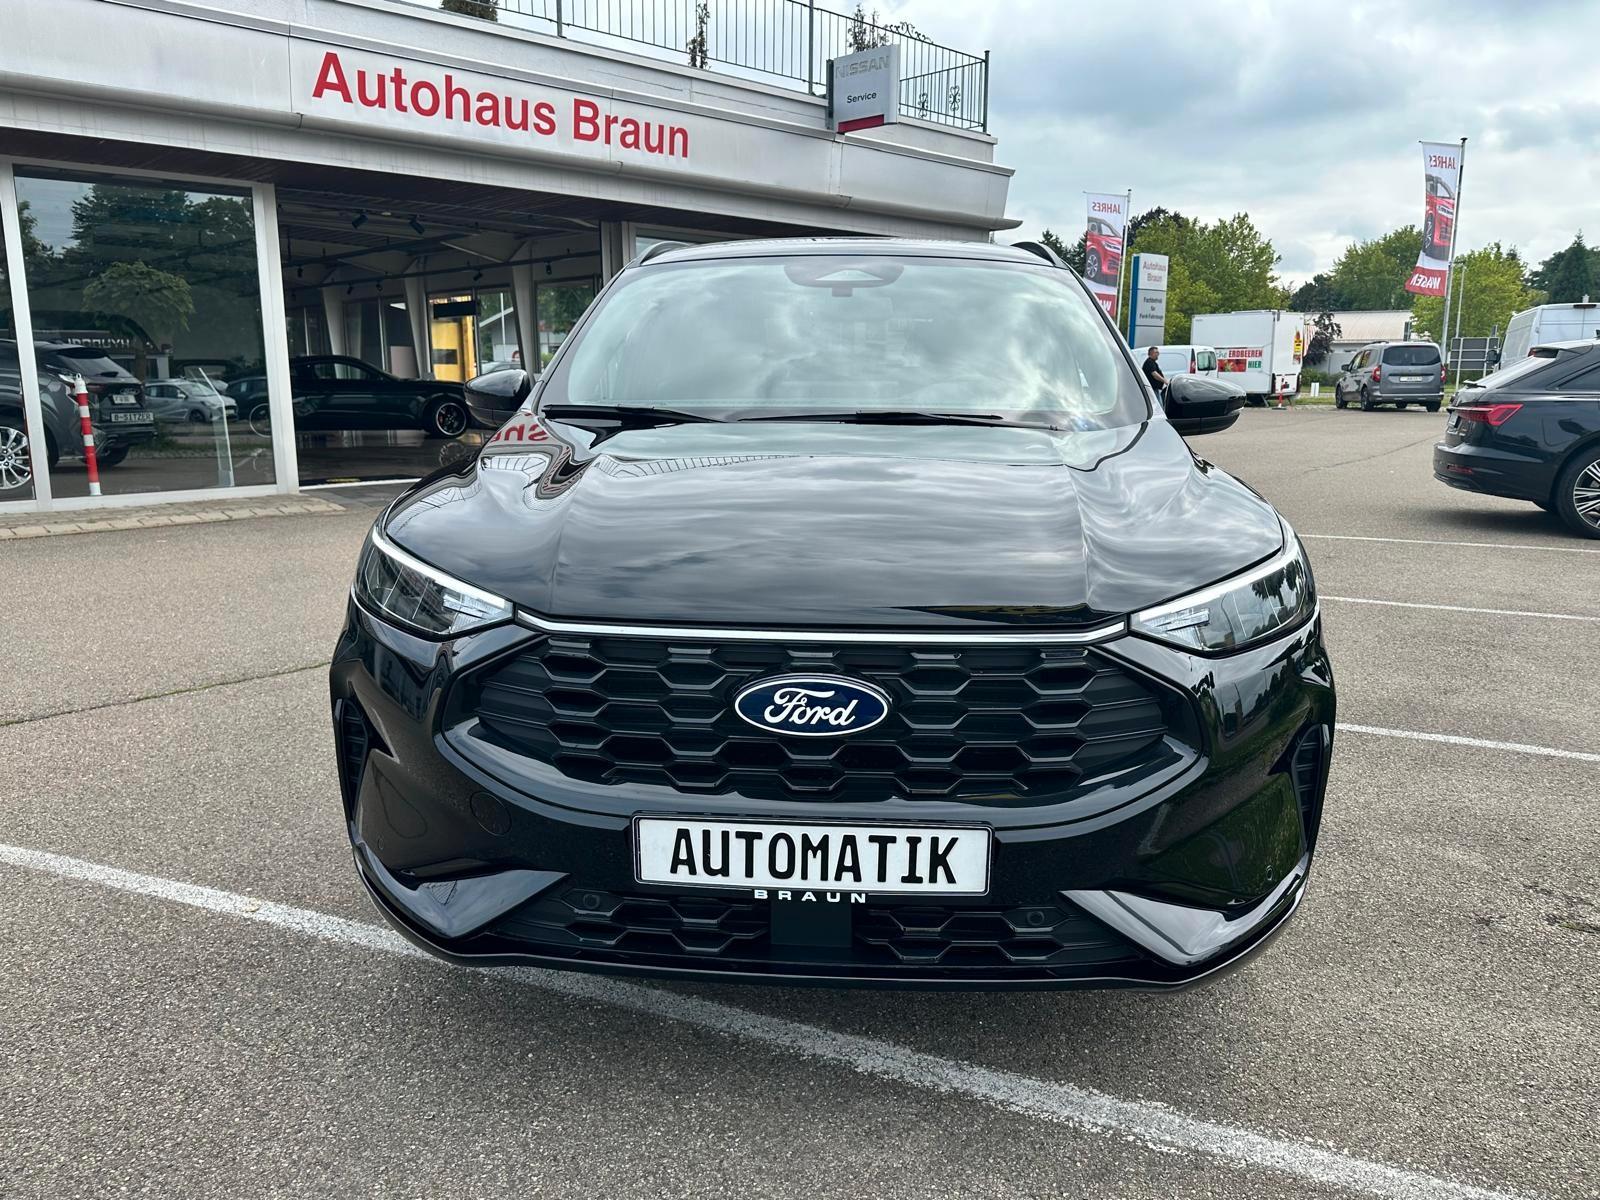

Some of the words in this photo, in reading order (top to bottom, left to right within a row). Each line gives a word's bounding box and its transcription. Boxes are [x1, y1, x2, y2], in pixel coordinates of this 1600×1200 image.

[835, 55, 890, 79] NISSAN
[312, 51, 557, 136] Autohaus
[573, 98, 689, 158] Braun
[846, 92, 877, 104] Service
[1228, 350, 1263, 358] ERDBEEREN
[764, 687, 857, 727] Ford
[670, 827, 959, 885] AUTOMATIK
[754, 890, 867, 904] BRAUN
